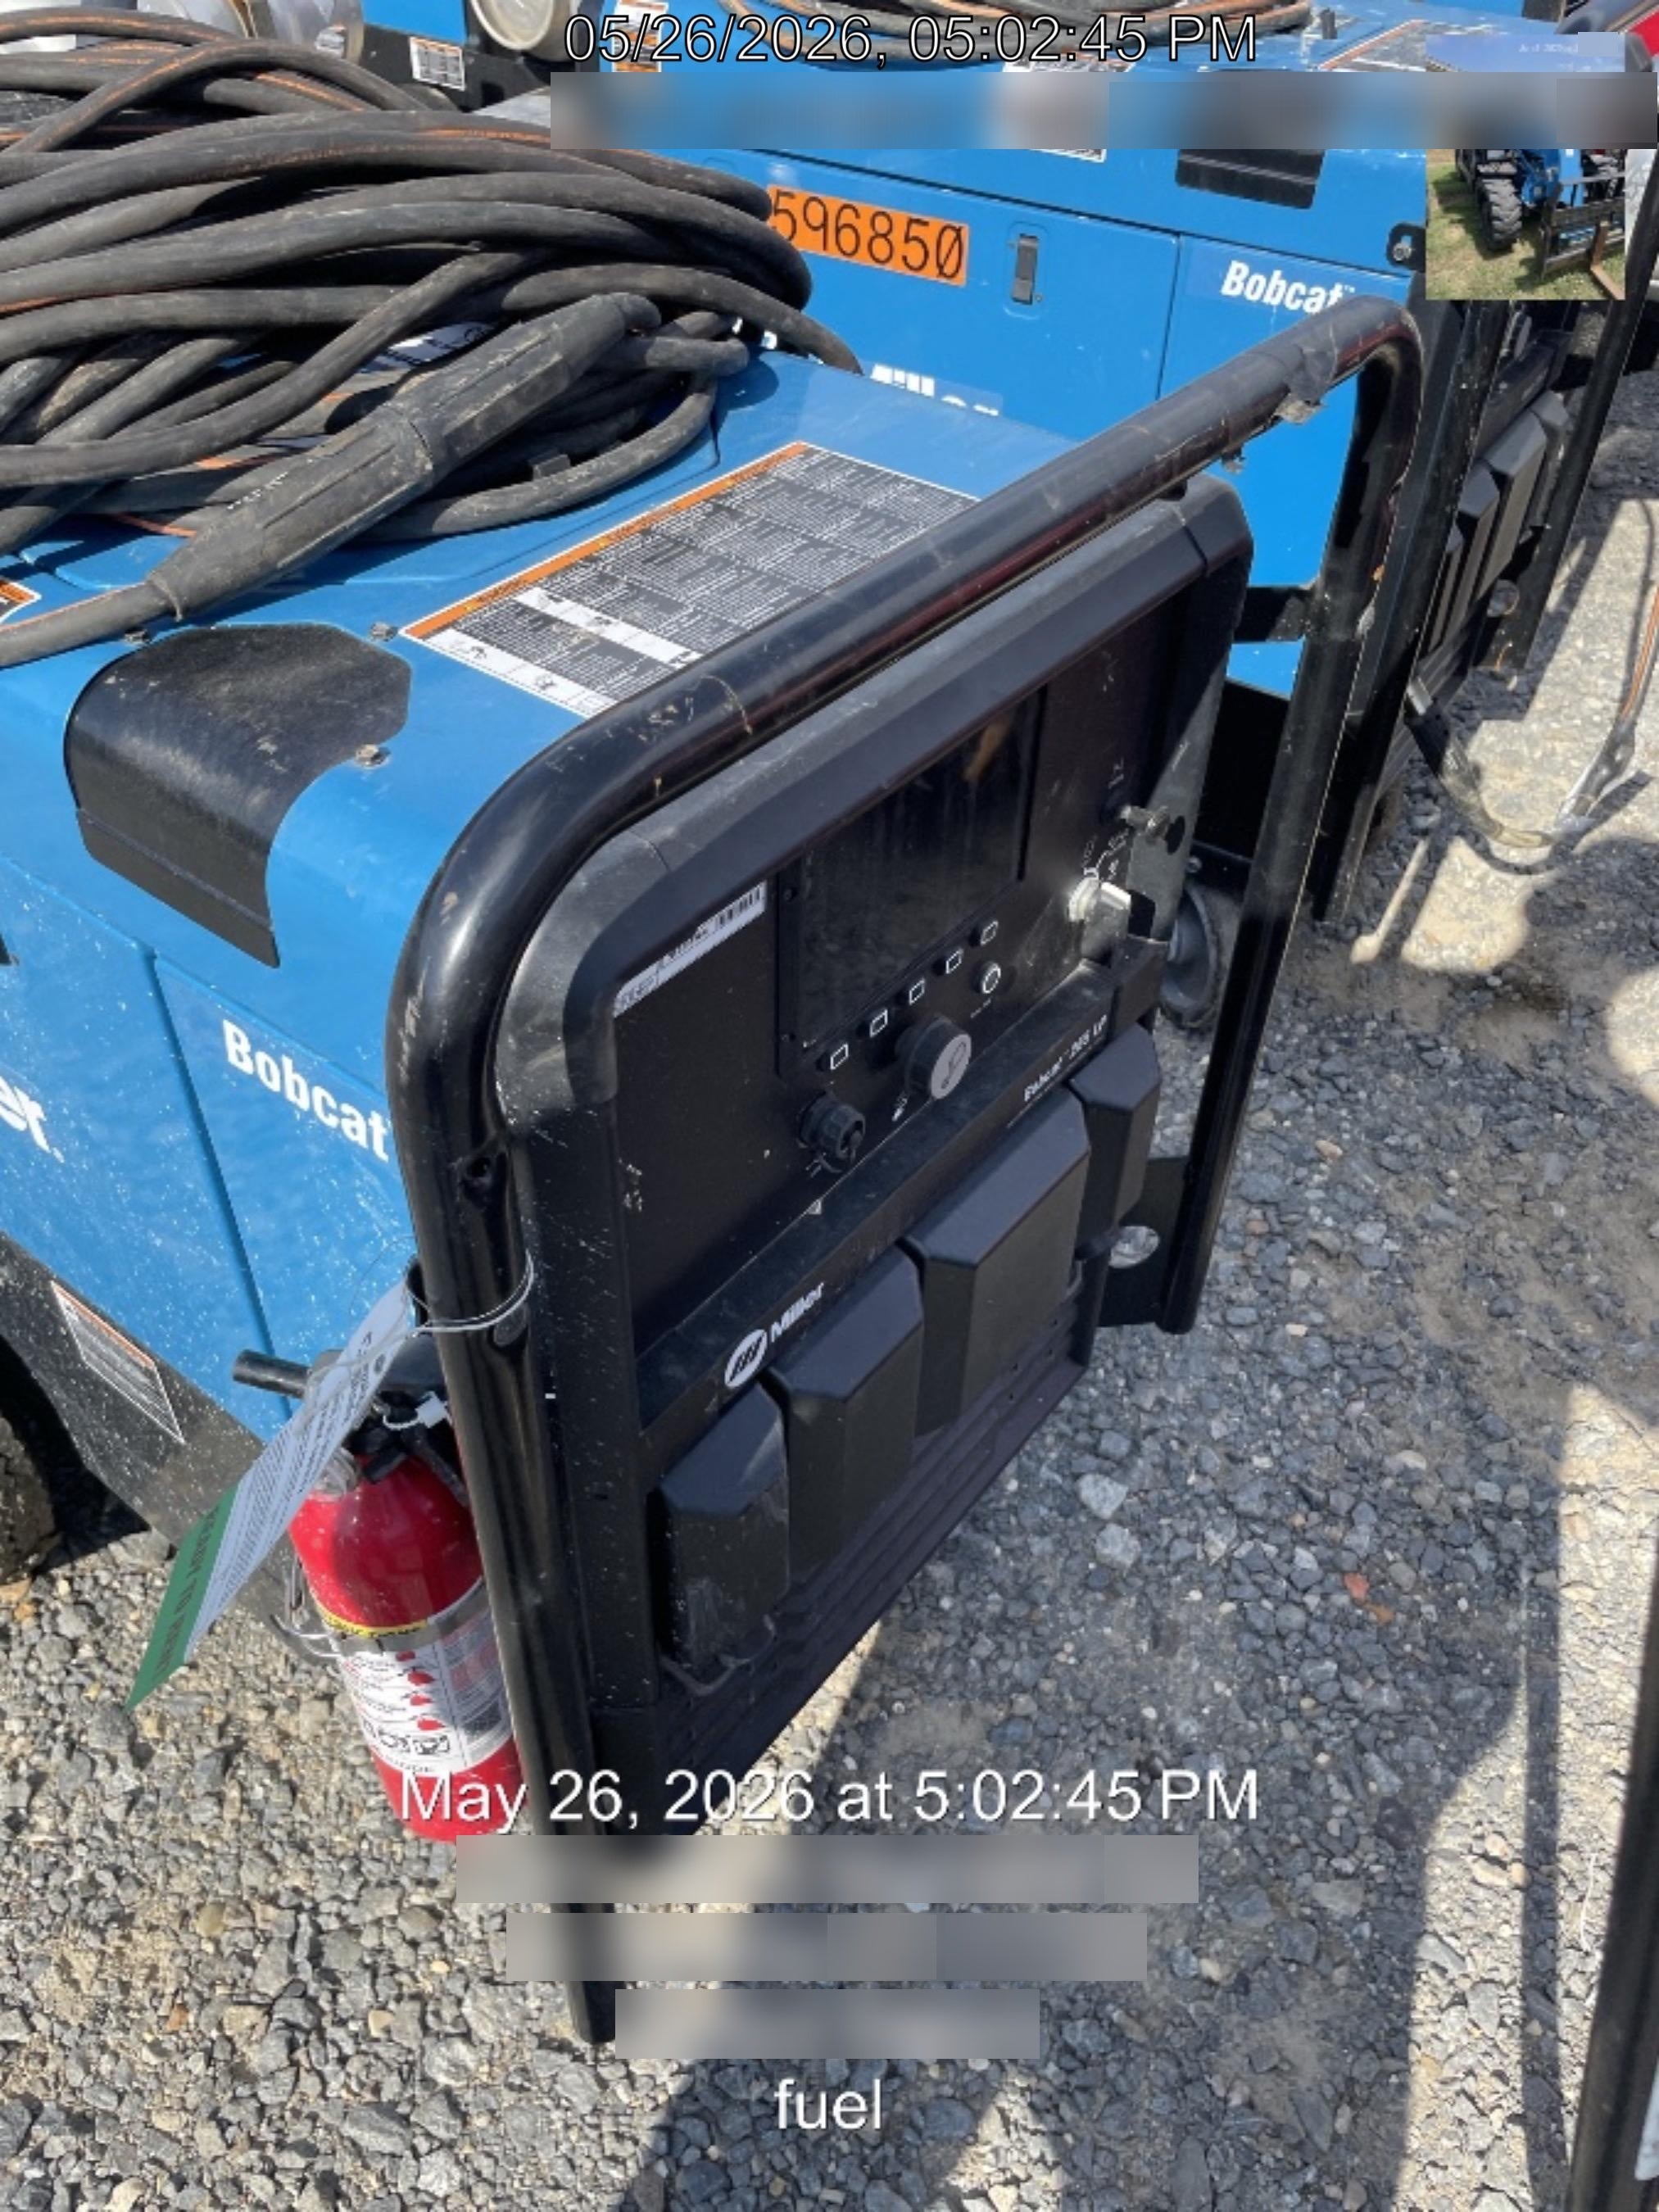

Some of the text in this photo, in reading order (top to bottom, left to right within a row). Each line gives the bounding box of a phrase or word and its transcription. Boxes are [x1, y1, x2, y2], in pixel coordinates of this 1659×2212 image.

[773, 190, 965, 279] 596850
[1221, 260, 1344, 315] Bobcat
[222, 1018, 389, 1163] Bobcat
